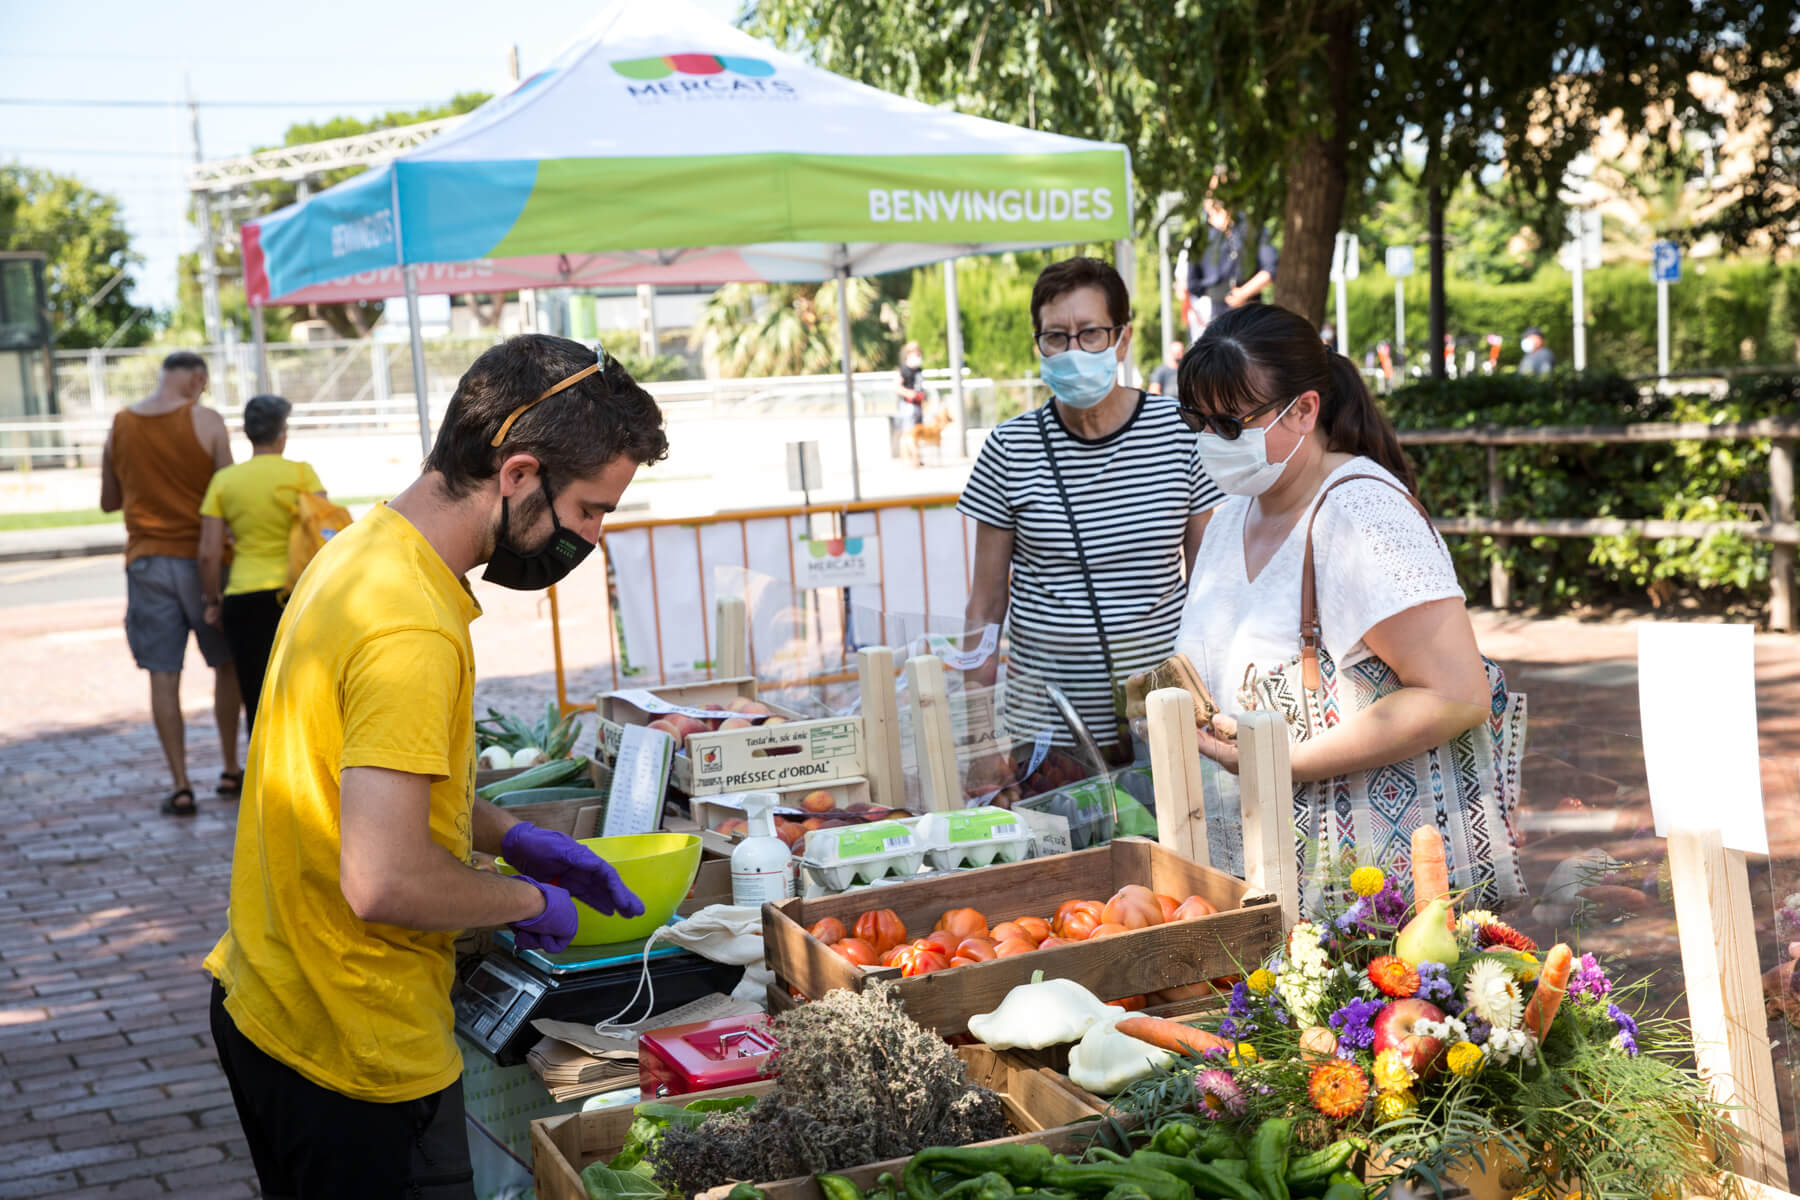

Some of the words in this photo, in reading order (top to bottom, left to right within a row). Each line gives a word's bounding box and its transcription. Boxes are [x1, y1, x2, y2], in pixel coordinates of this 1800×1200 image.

[626, 78, 796, 97] MERCATS
[868, 188, 1114, 222] BENVINGUDES
[726, 769, 776, 786] PRÉSSEC
